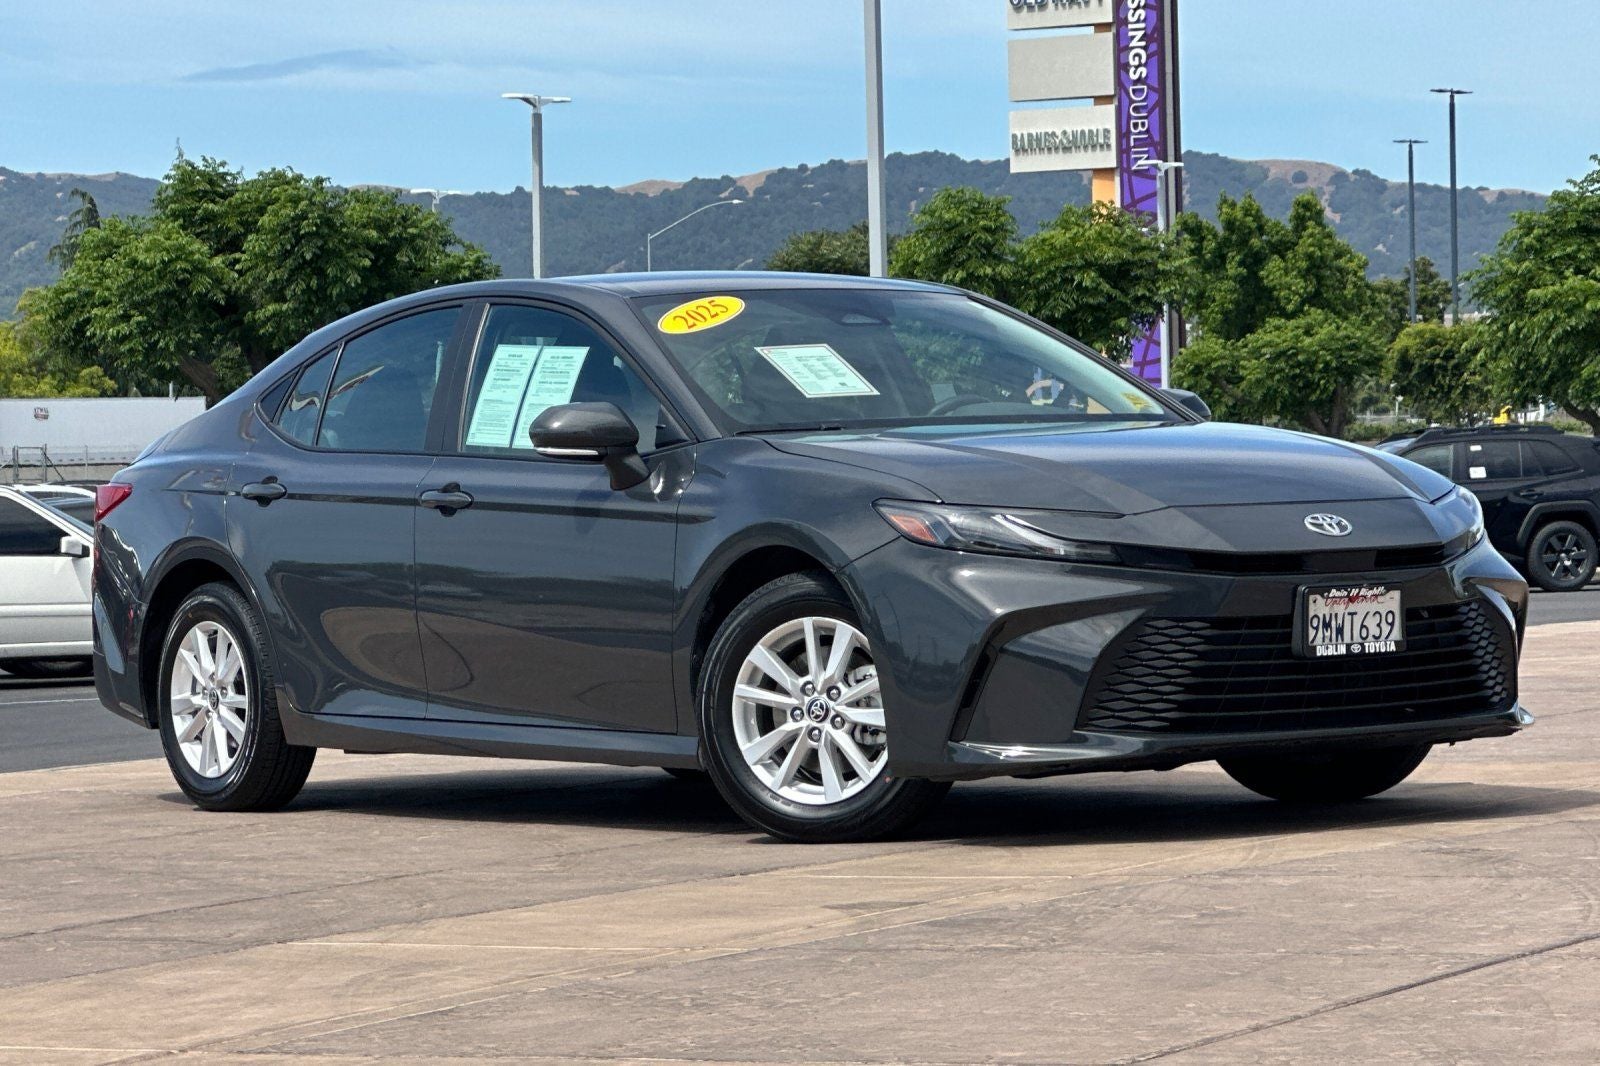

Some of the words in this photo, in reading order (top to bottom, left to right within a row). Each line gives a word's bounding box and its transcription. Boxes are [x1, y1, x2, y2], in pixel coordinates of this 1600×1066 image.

[1129, 85, 1150, 171] DUBLIN
[672, 299, 729, 330] 2025
[1310, 610, 1396, 645] 9MWT639
[1316, 644, 1346, 656] DUBLIN
[1364, 641, 1396, 653] TOYOTA
